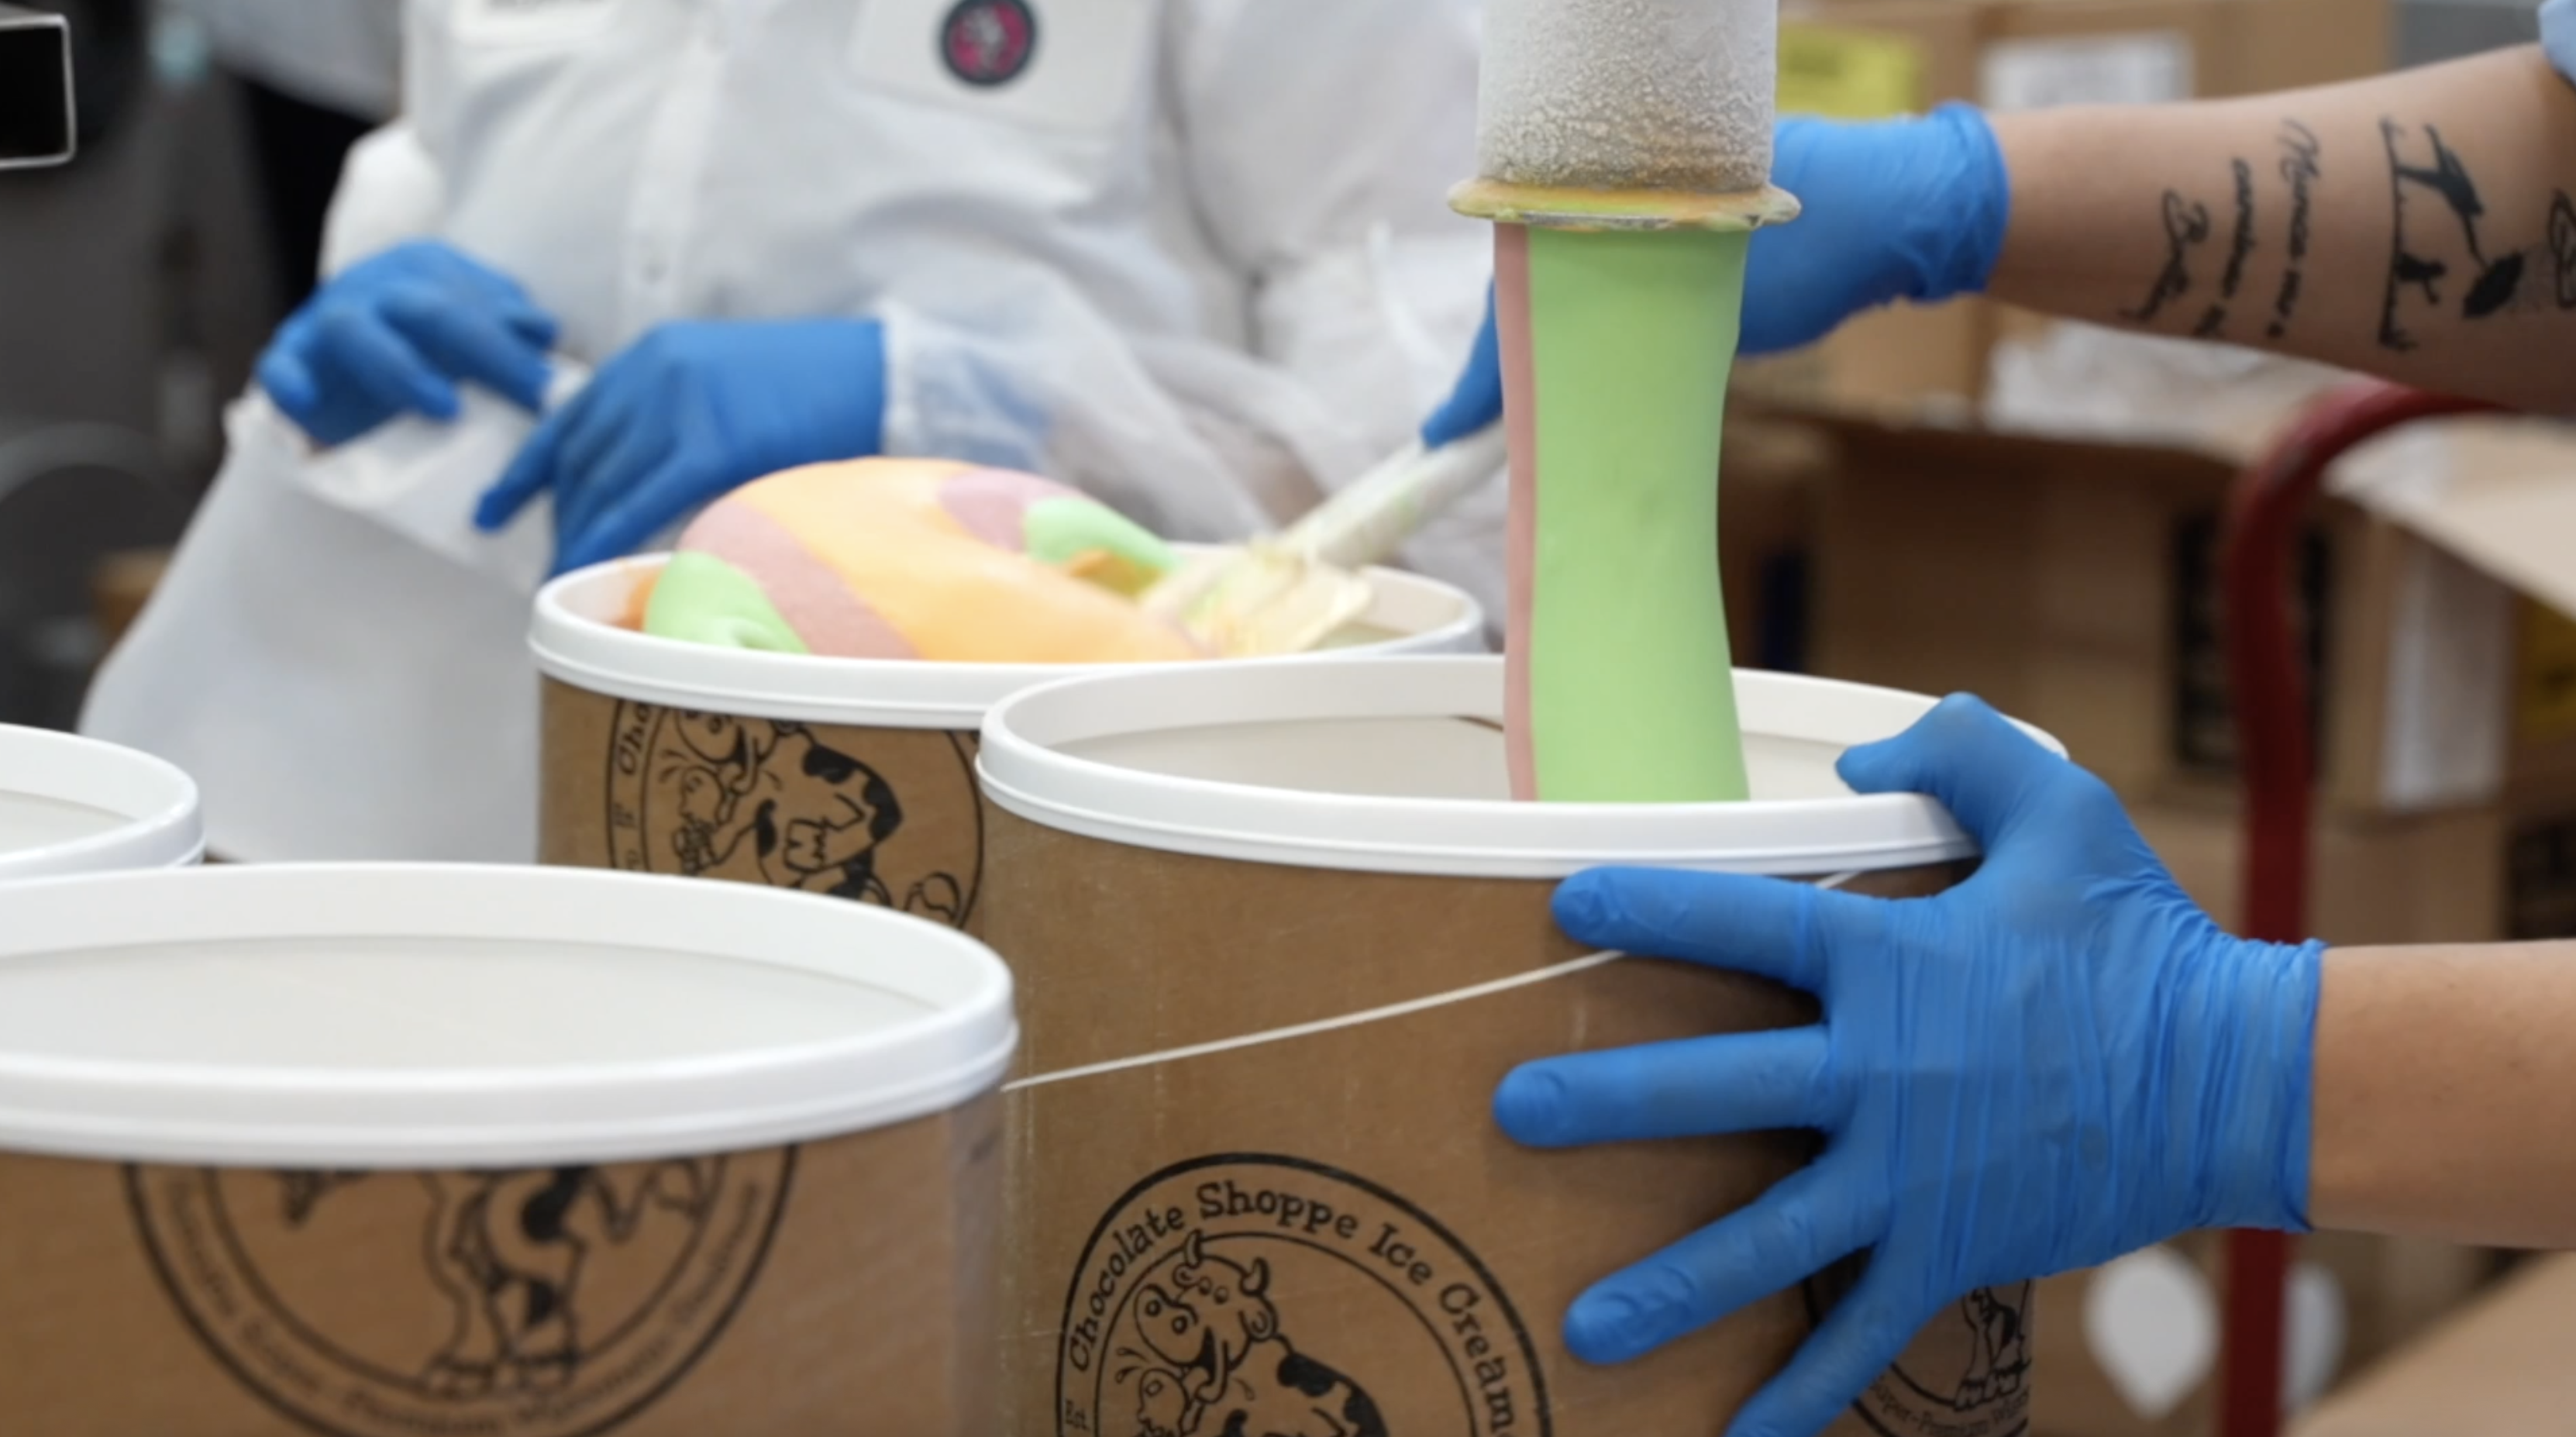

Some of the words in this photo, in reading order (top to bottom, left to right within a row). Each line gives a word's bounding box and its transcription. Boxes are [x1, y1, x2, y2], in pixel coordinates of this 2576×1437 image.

[1069, 1204, 1186, 1372] Chocolate
[1196, 1180, 1359, 1239] Shoppe
[1368, 1222, 1434, 1286] Ice
[1438, 1282, 1514, 1434] Cream
